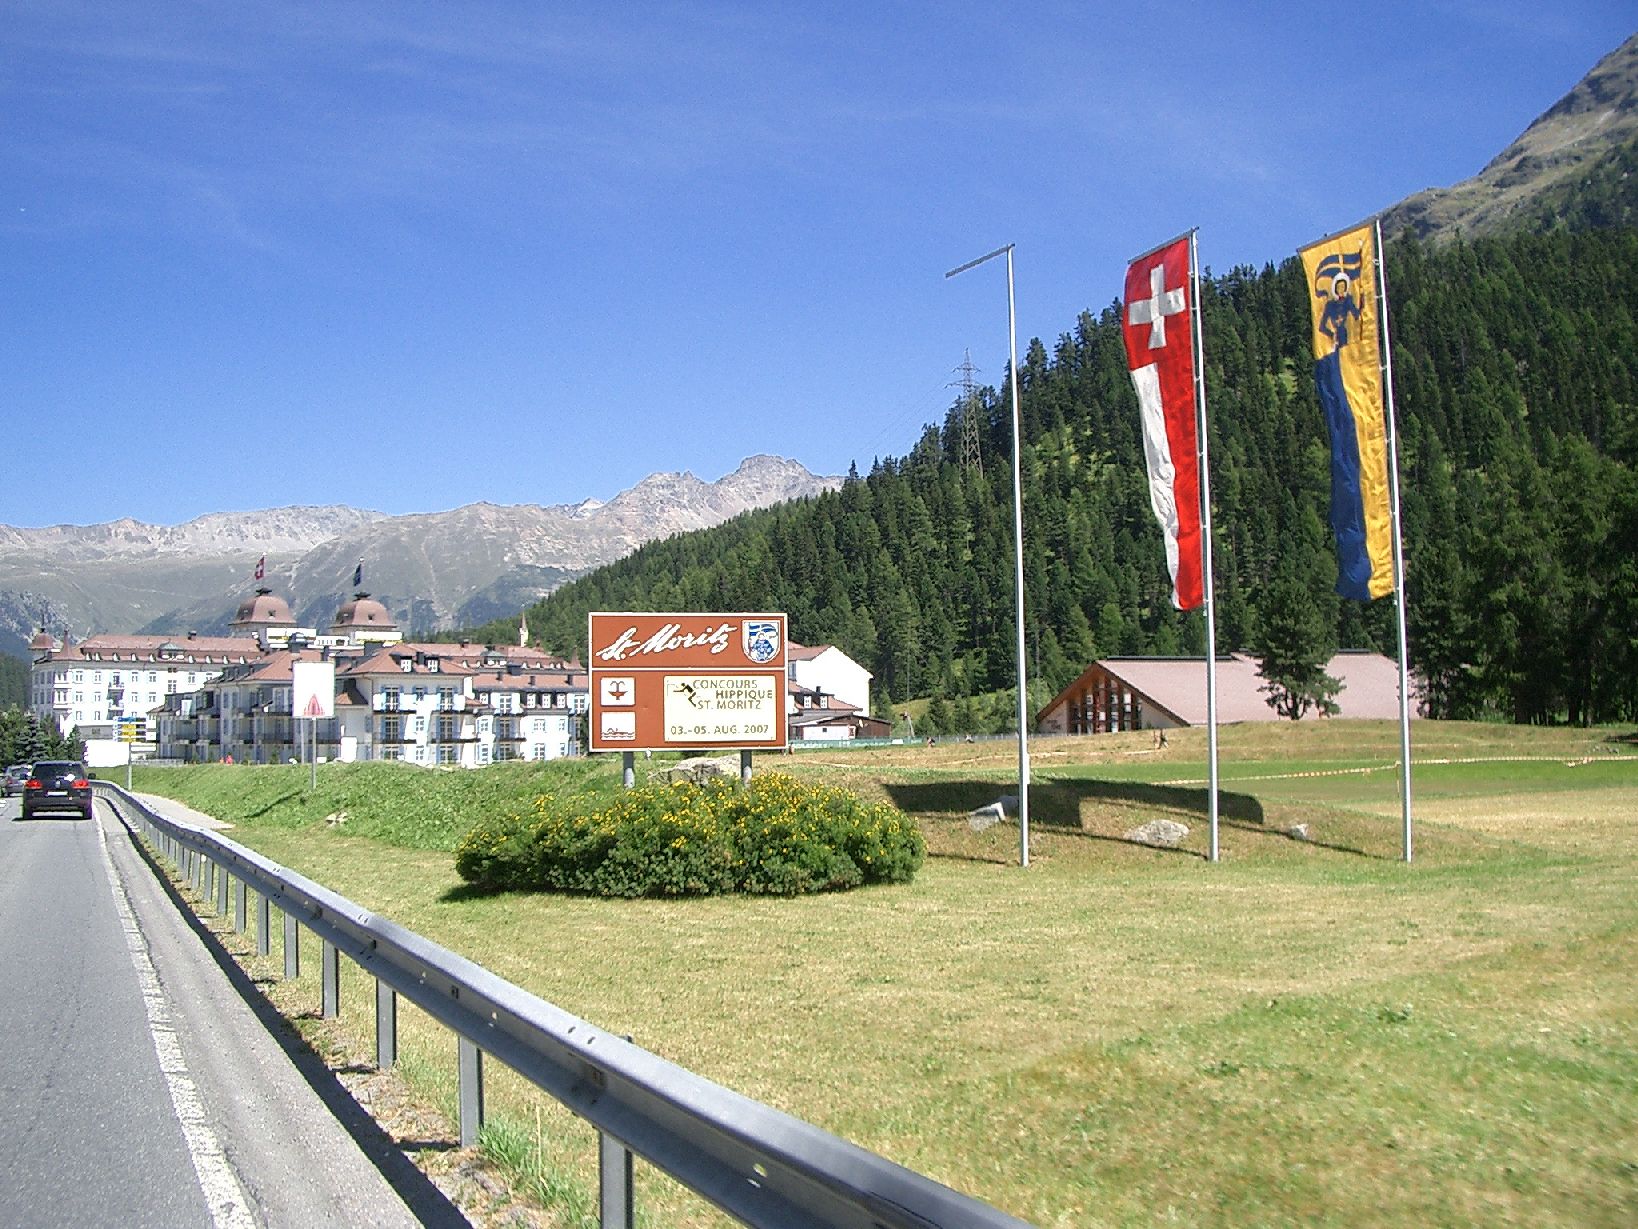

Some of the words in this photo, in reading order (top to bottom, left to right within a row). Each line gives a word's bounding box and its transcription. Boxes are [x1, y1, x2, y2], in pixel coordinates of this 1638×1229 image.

[595, 627, 641, 661] St.
[629, 623, 737, 654] Moritz
[692, 679, 758, 689] CONCOURS
[715, 689, 773, 699] HIPPIQUE
[697, 700, 714, 710] ST.
[716, 700, 761, 710] MORITZ
[714, 725, 740, 735] AUG.
[744, 724, 769, 734] 2007
